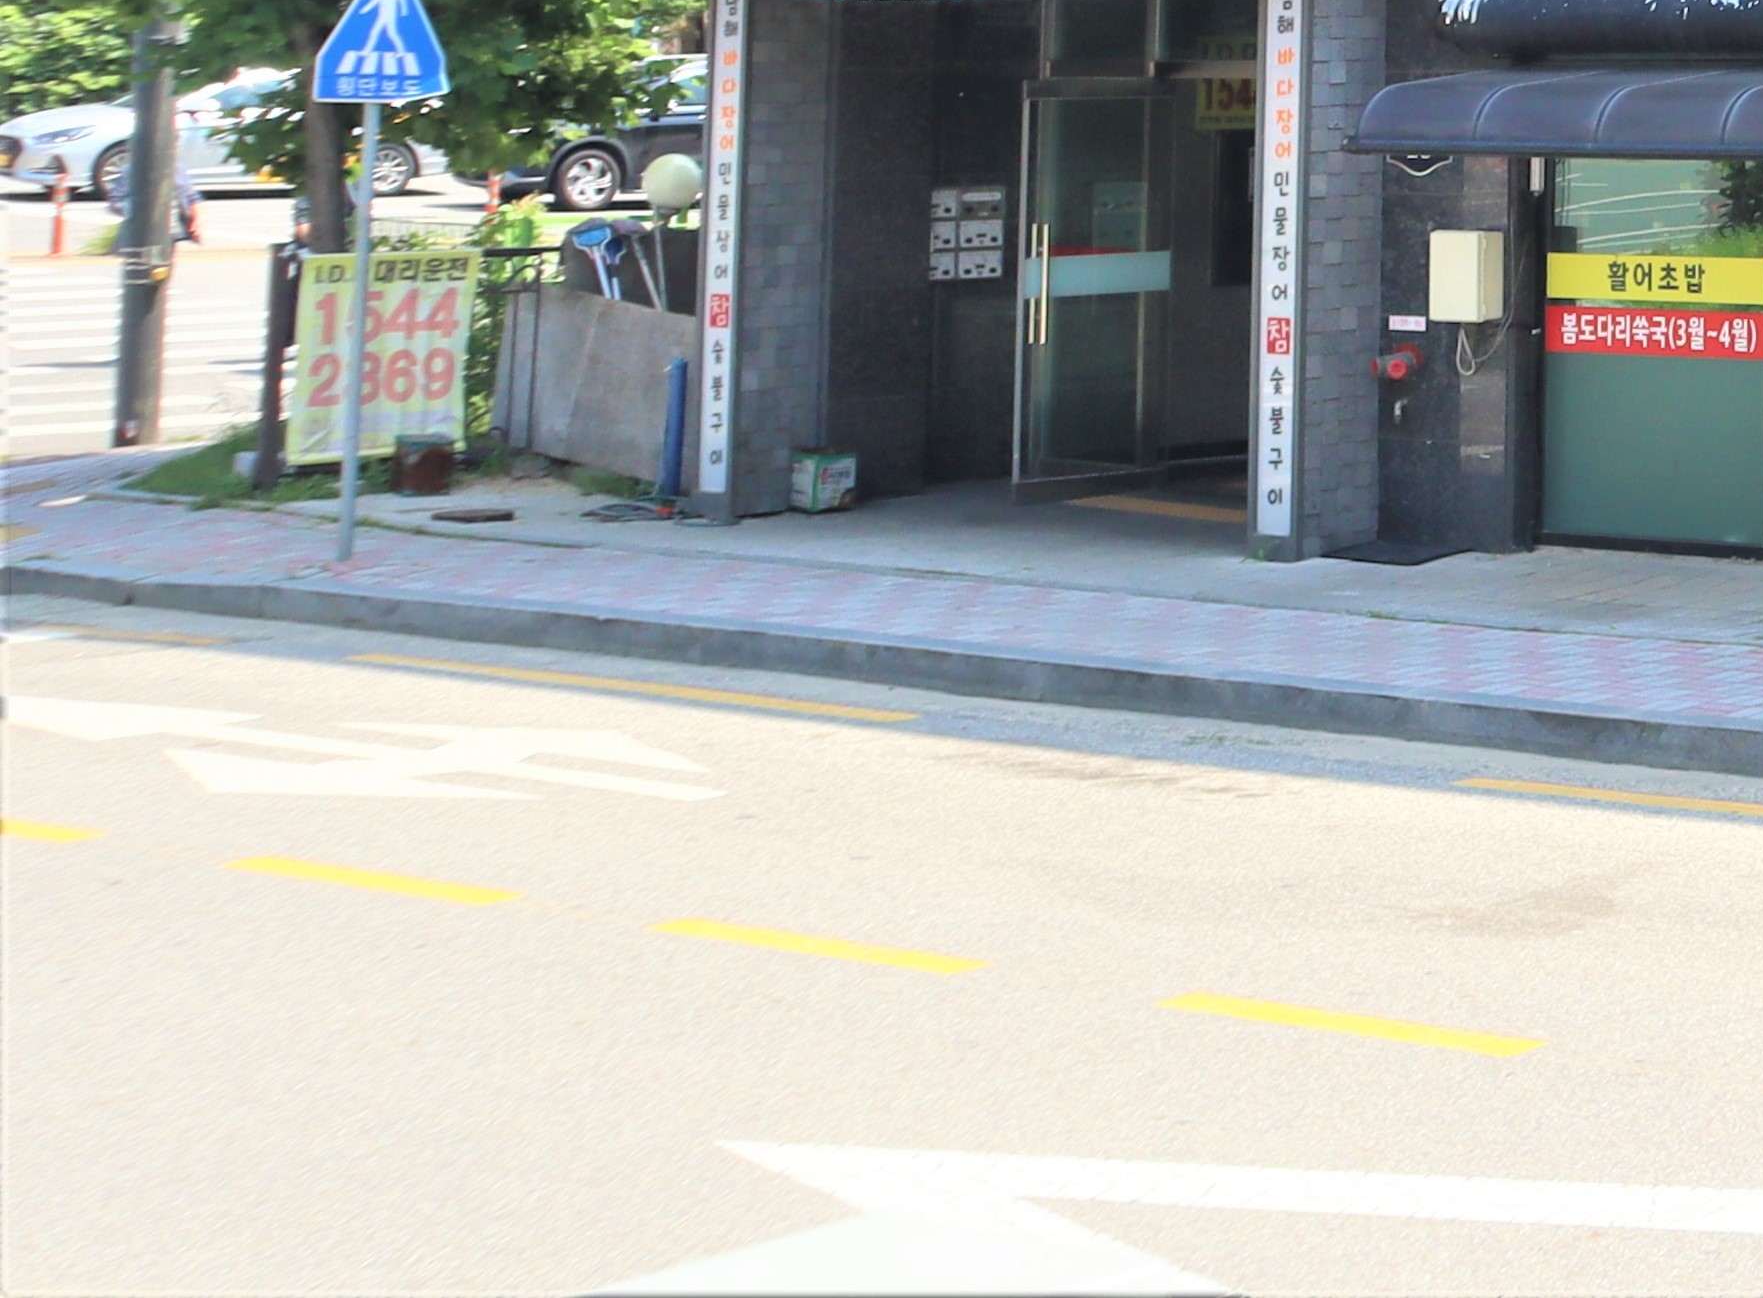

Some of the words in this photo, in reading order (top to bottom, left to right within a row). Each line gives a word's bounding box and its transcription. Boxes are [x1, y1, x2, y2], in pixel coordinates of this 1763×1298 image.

[336, 75, 423, 96] 횡단보도
[1202, 78, 1256, 112] 154
[373, 257, 469, 283] 대리운전
[1607, 260, 1706, 295] 활어초밥
